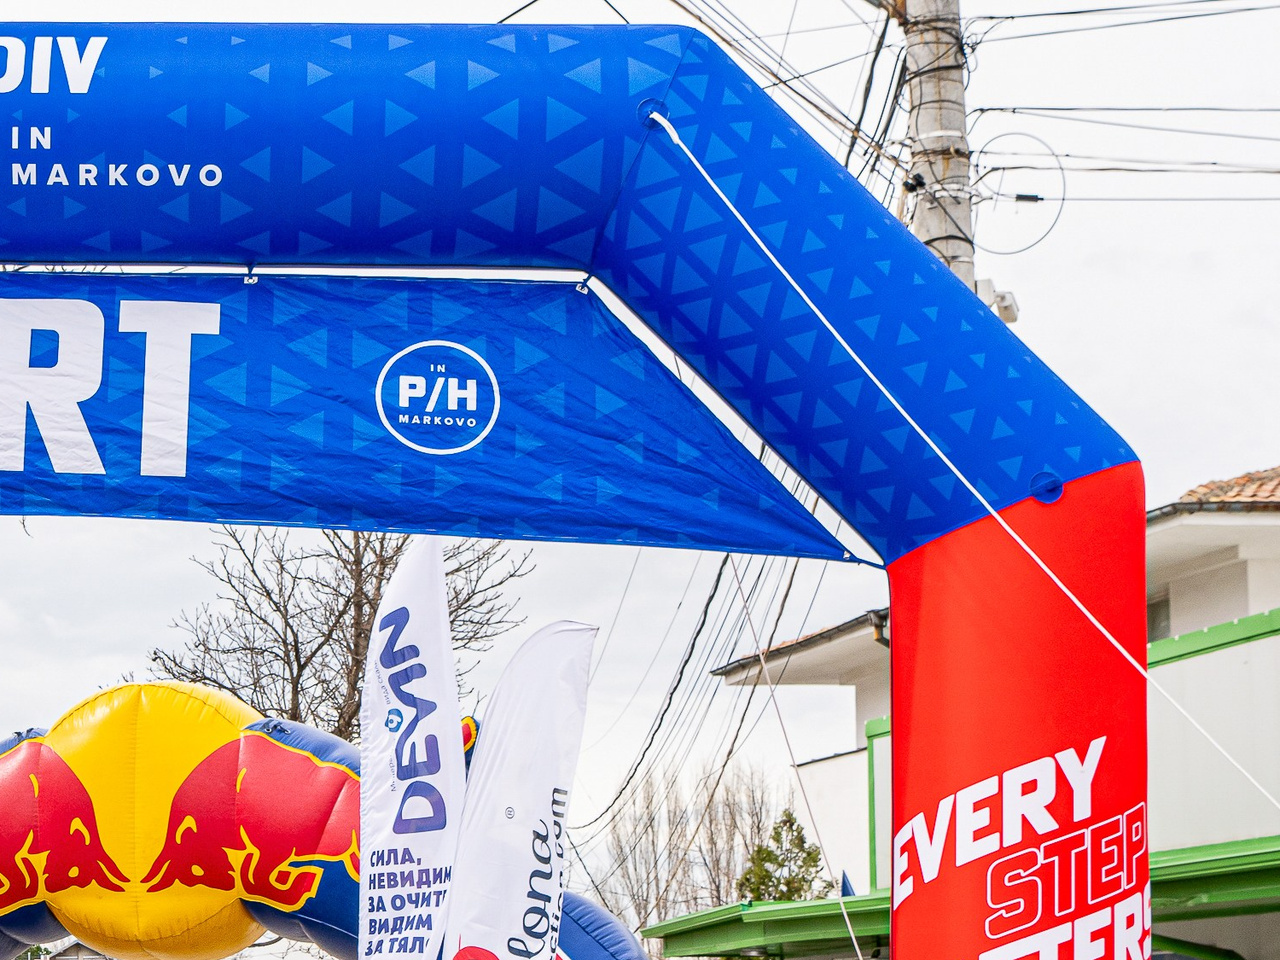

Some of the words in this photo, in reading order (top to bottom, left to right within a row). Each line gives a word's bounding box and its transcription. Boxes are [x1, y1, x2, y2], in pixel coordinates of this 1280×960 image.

[10, 126, 52, 150] IN
[10, 163, 224, 187] MARKOVO
[430, 364, 446, 373] IN
[399, 375, 477, 412] P/H
[399, 414, 477, 427] MARKOVO
[379, 606, 447, 835] DEVIN
[893, 735, 1107, 911] EVERY
[369, 866, 452, 890] НЕВИДИМ
[984, 801, 1148, 939] STEP
[368, 896, 387, 913] ЗА
[369, 914, 432, 935] ВИДИМ
[365, 939, 384, 956] ЗА
[388, 937, 429, 953] ТЯЛ
